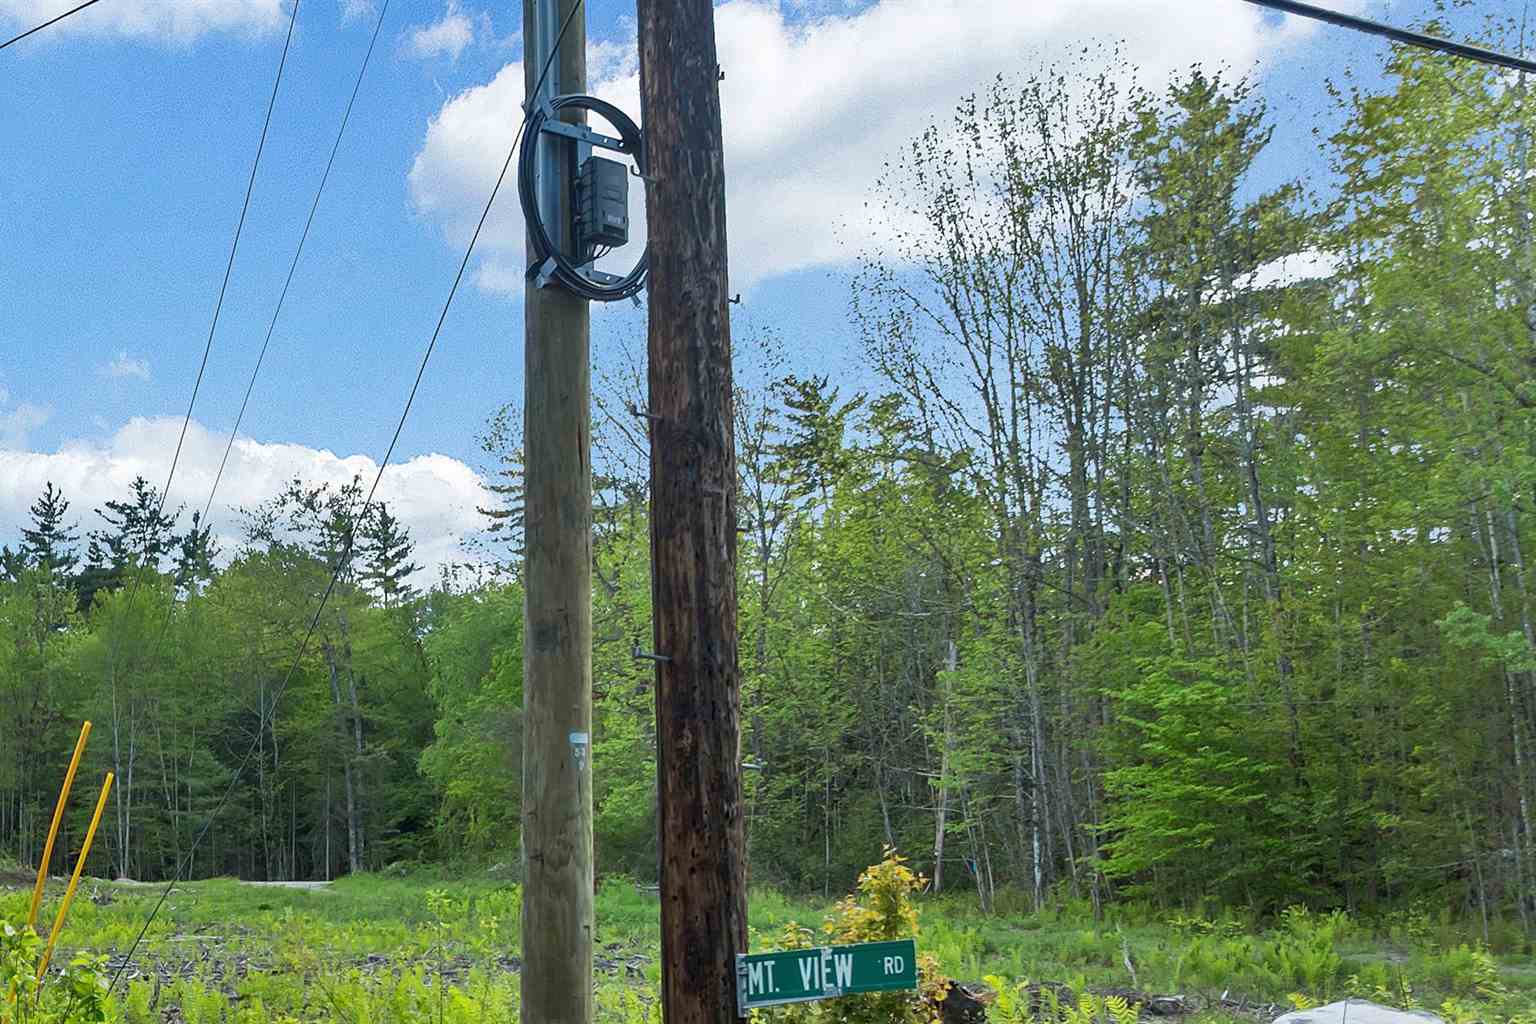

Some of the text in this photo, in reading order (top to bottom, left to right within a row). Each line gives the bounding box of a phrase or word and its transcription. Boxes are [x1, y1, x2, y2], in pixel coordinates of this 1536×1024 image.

[747, 954, 905, 995] MT. VIEW RD
